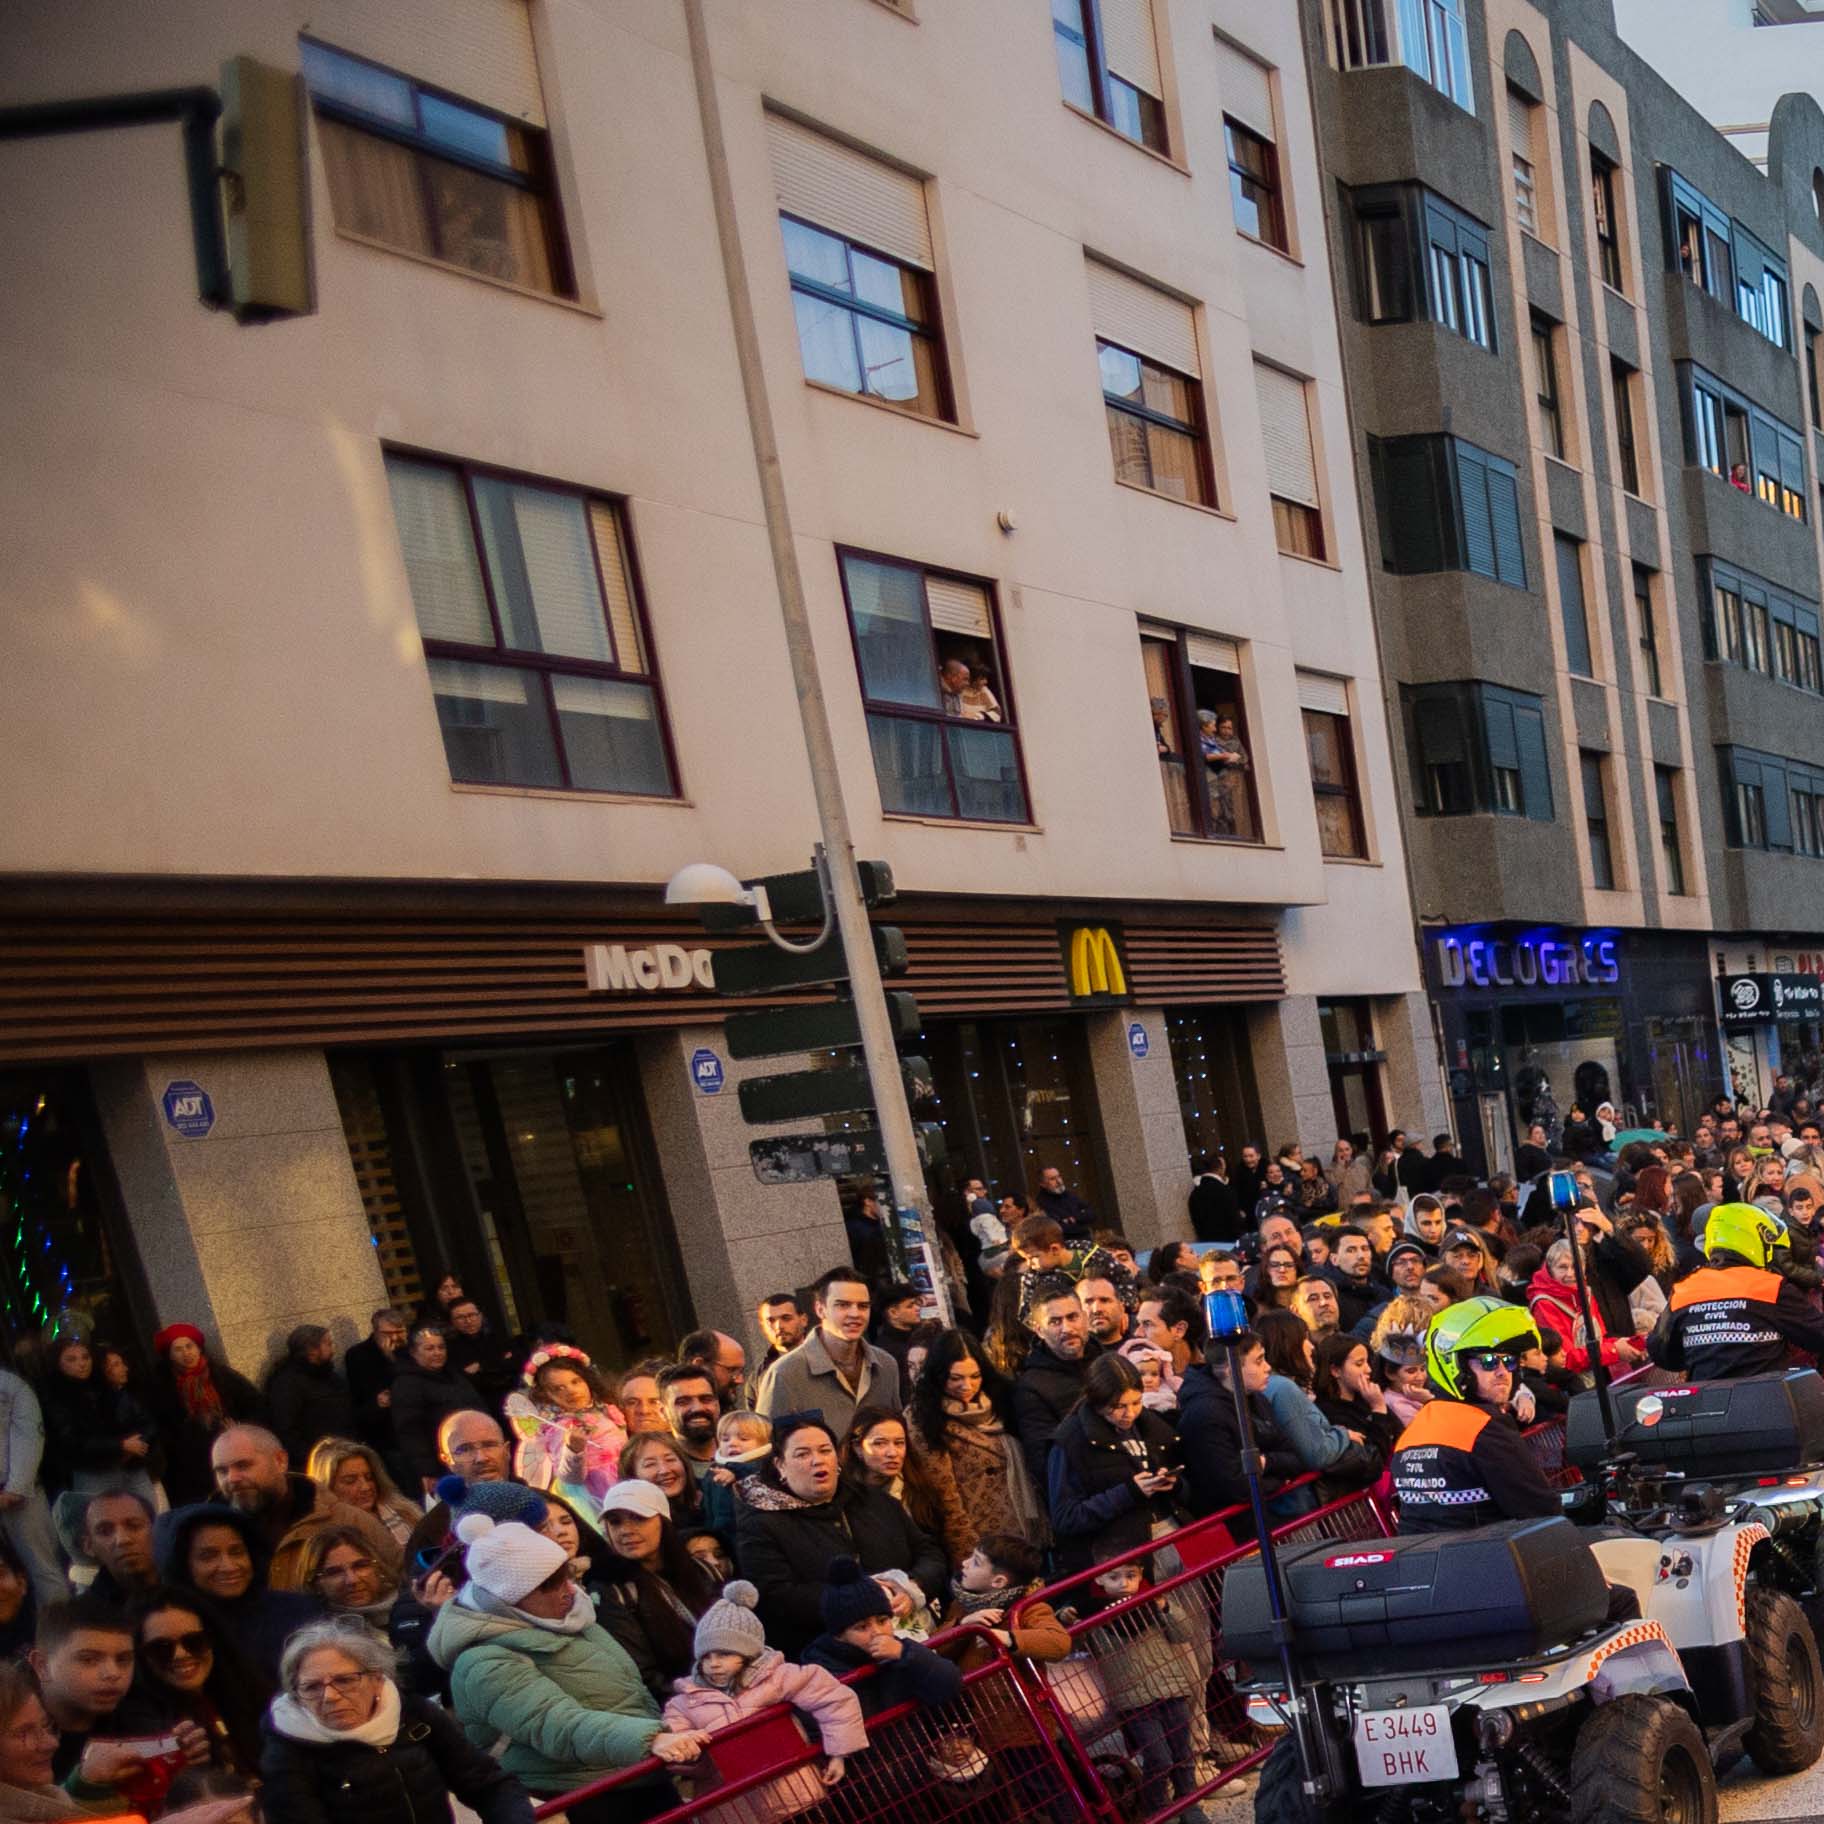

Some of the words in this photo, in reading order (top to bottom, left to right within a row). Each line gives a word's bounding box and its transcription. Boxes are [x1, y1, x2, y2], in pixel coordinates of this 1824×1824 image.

[175, 1096, 203, 1117] ADT
[1688, 1300, 1747, 1314] PROTECCION
[1704, 1311, 1728, 1320] CIVIL
[1686, 1322, 1751, 1334] VOLUNTARIADO
[1364, 1718, 1378, 1742] E
[1383, 1712, 1438, 1740] 3449
[1383, 1749, 1430, 1777] BHK
